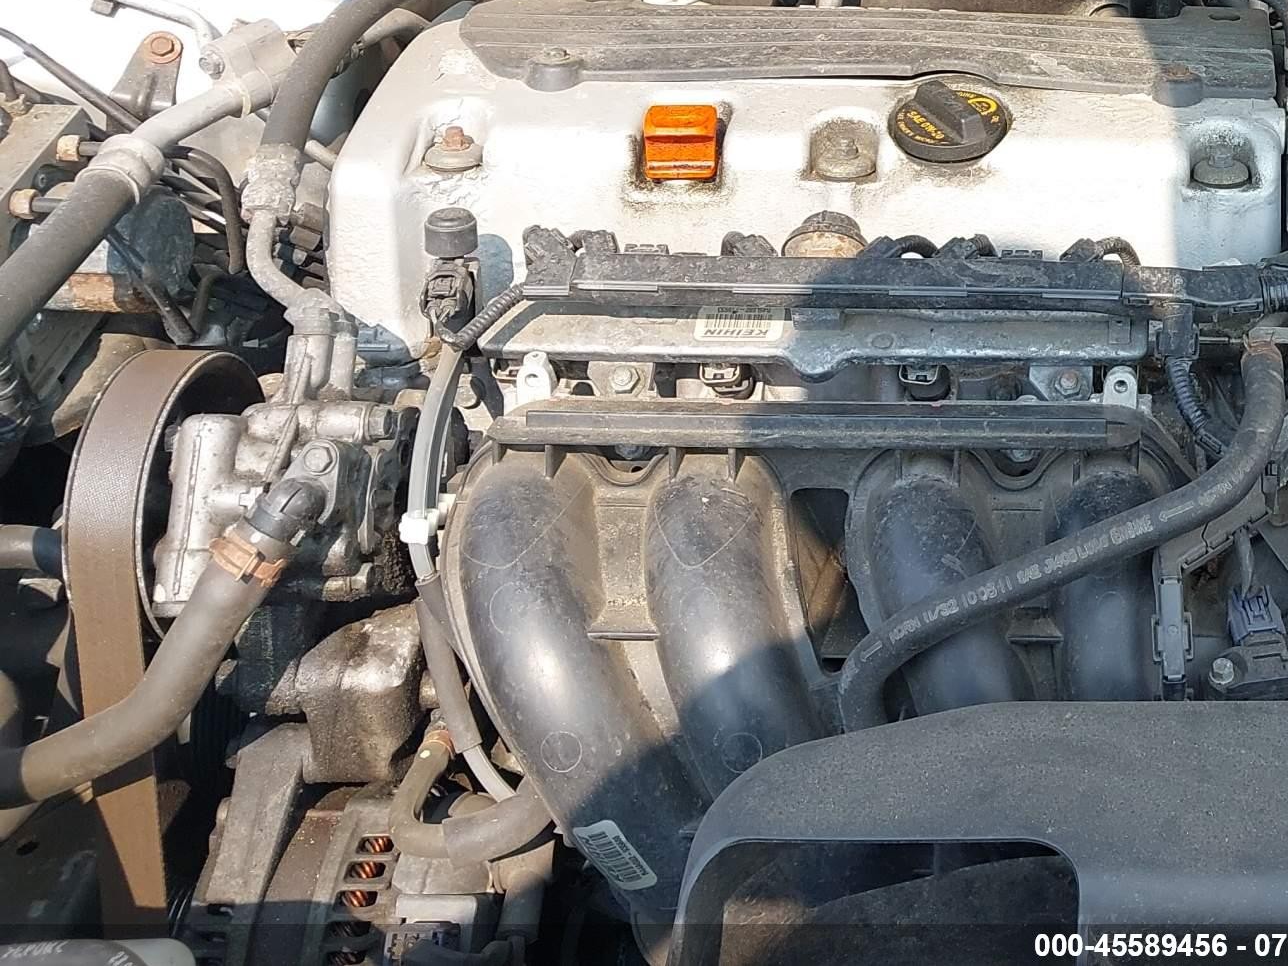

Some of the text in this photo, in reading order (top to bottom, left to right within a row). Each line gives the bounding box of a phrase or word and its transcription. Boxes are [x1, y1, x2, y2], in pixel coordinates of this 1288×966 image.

[906, 110, 927, 124] SAE
[920, 122, 945, 140] 0W-20
[703, 328, 769, 336] KEIHIN
